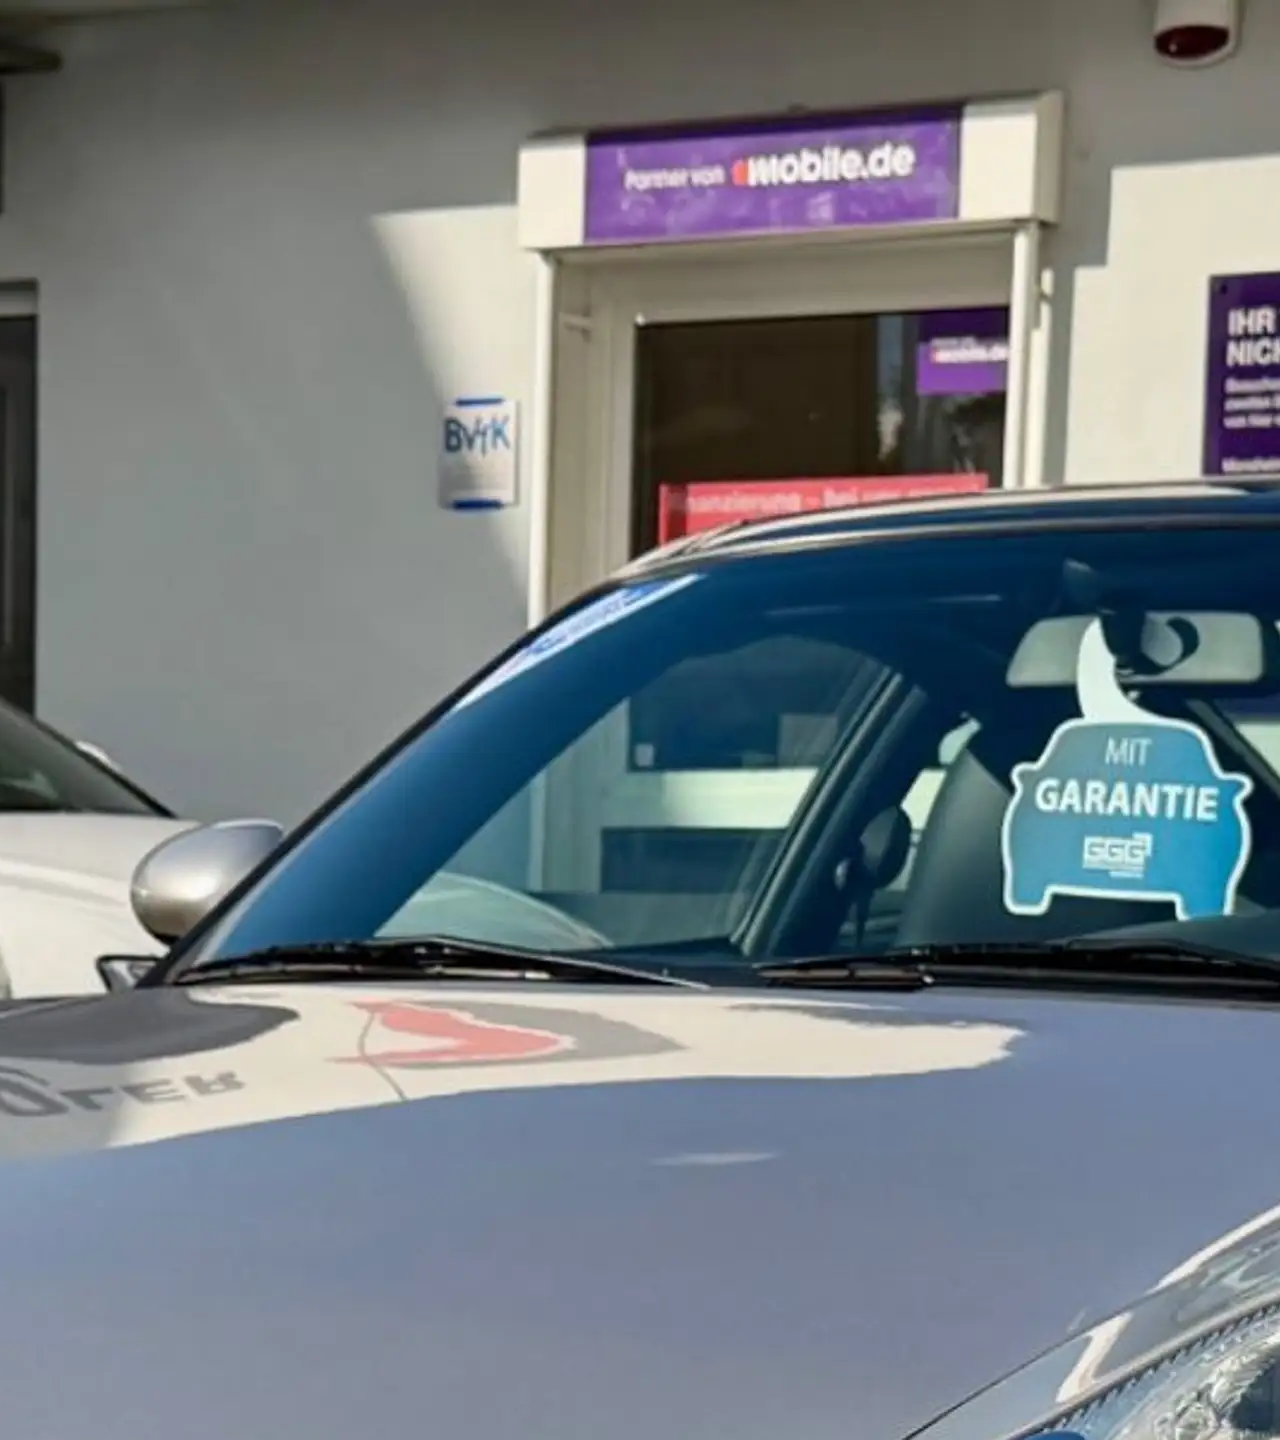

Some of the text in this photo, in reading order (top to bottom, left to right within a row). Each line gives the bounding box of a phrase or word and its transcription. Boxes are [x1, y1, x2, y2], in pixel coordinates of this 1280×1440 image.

[747, 143, 916, 187] mobile.de
[1227, 308, 1276, 336] IHR
[1104, 736, 1153, 767] MIT
[1034, 777, 1219, 822] GARANTIE
